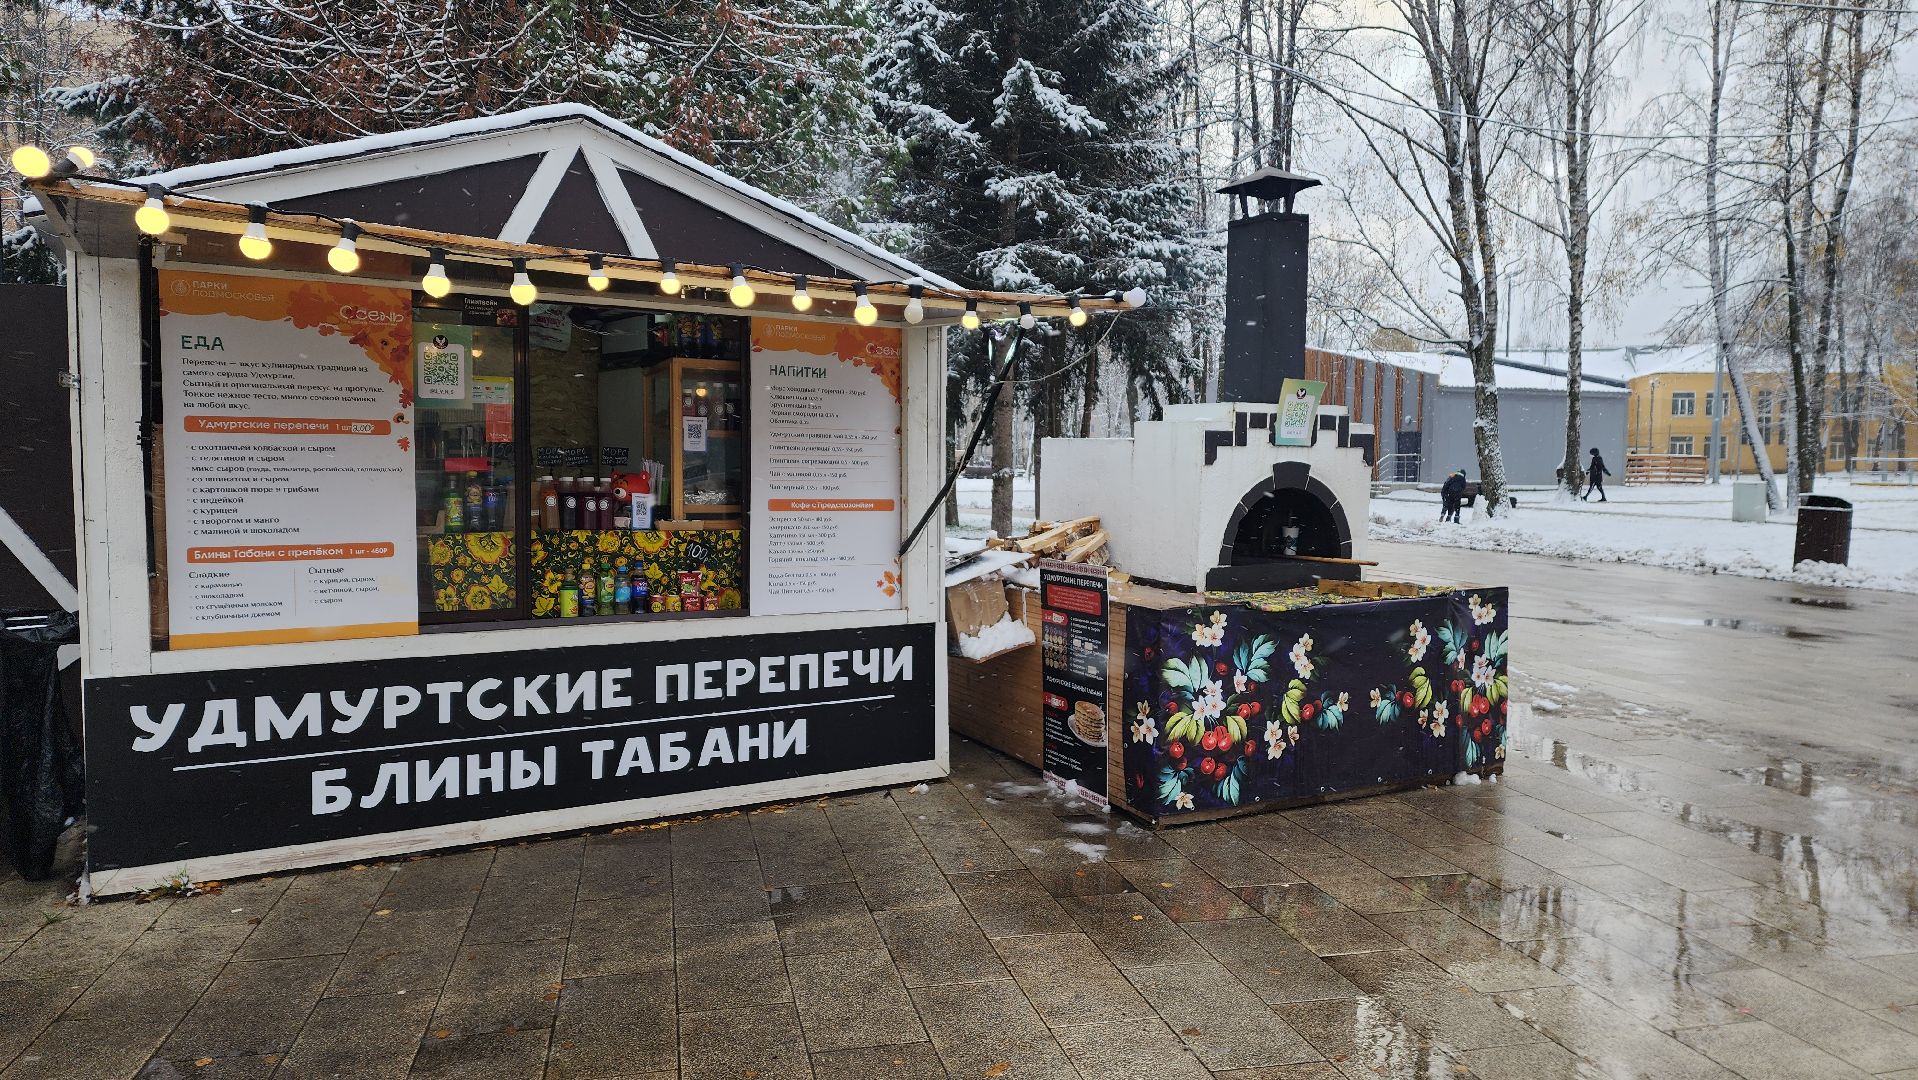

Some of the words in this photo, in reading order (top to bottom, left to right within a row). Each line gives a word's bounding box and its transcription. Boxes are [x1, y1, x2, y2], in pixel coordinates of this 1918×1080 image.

[193, 281, 227, 289] ПАРКИ
[193, 290, 274, 301] ПОДМОСКОВЬЯ
[465, 298, 498, 306] Глинтвейн
[182, 335, 224, 351] ЕДА
[770, 365, 827, 379] НАПИТКИ
[198, 419, 270, 430] Удмуртские
[273, 421, 329, 431] перепечи
[792, 501, 810, 509] Кофе
[817, 501, 874, 509] Предсказанием
[194, 551, 230, 559] Блины
[234, 550, 275, 558] Табани
[288, 548, 343, 558] препёком
[1044, 573, 1076, 585] УДМУРТСКИЕ
[1077, 578, 1103, 589] ПЕРЕПЕЧИ
[130, 667, 633, 753] УДМУРТСКИЕ
[656, 646, 915, 706] ПЕРЕПЕЧИ
[311, 744, 558, 816] БЛИНЫ
[582, 718, 808, 780] ТАБАНИ
